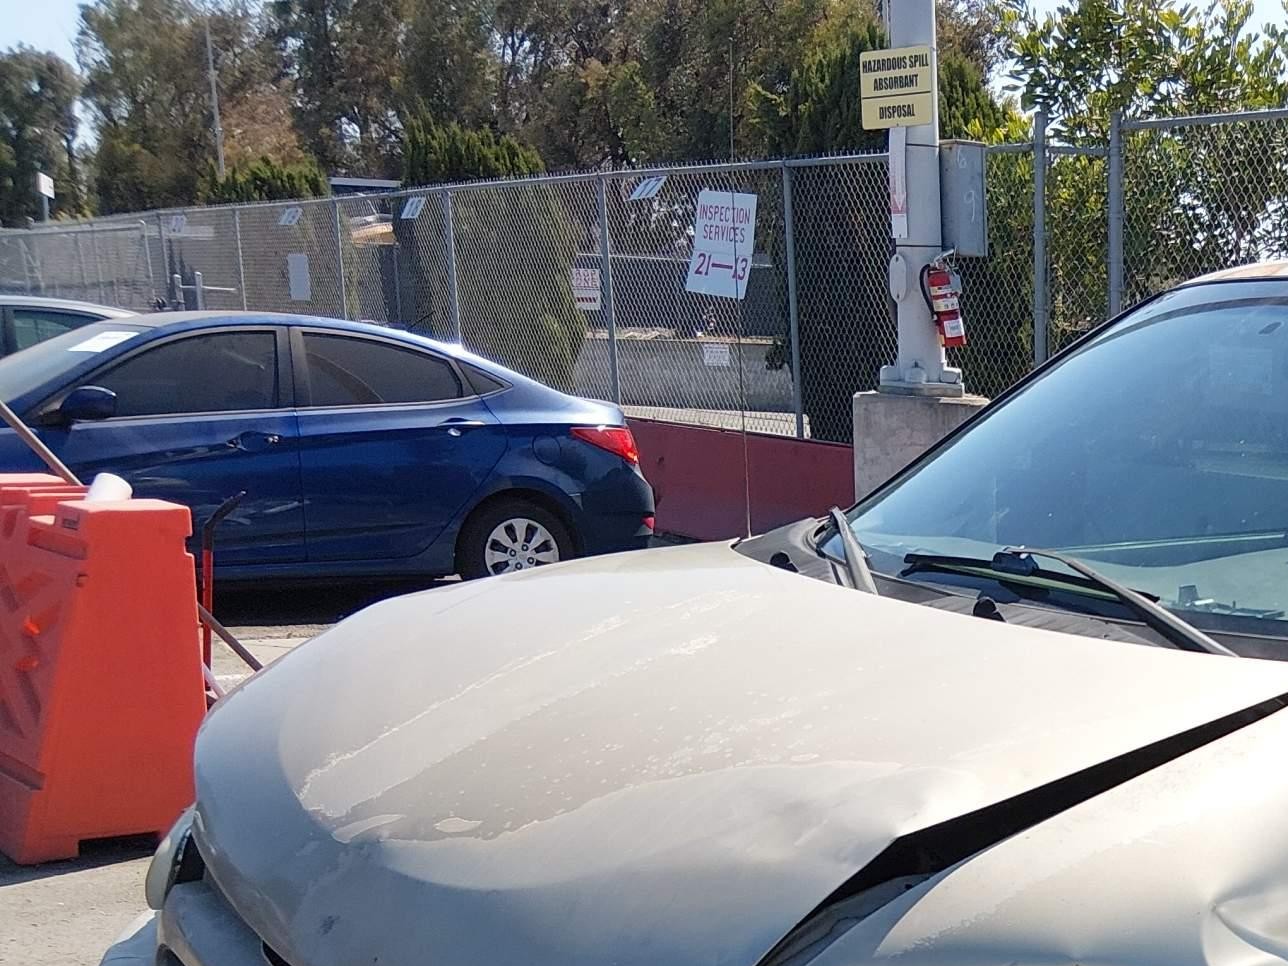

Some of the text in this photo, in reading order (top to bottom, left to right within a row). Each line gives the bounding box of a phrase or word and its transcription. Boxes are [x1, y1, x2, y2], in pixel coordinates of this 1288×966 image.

[862, 53, 929, 74] HAZARDOUS SPILL
[873, 73, 919, 92] ABSORBANT
[879, 103, 916, 120] DISPOSAL
[699, 203, 751, 225] INSPECTION
[703, 223, 746, 244] SERVICES
